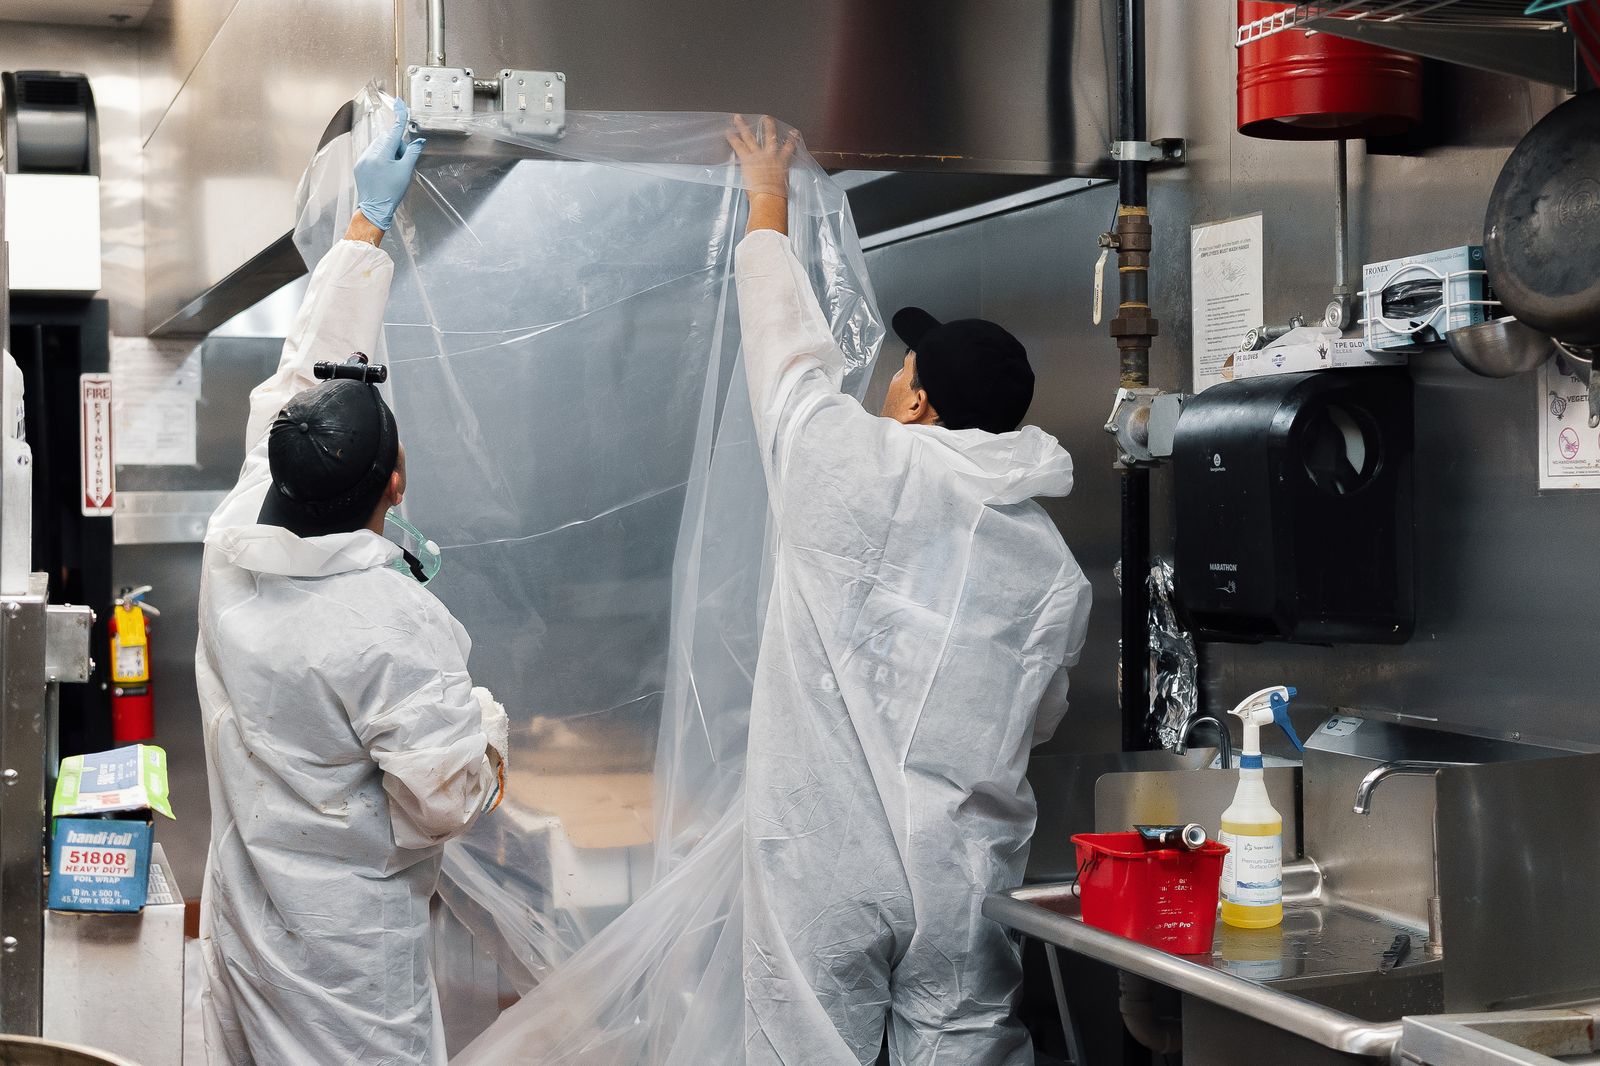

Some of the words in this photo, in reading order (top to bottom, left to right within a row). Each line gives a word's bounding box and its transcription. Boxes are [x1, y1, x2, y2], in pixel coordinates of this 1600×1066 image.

[1365, 264, 1389, 275] TRONEX
[1242, 353, 1259, 361] GLOVES
[86, 387, 110, 399] FIRE
[94, 402, 103, 501] EXTINGUISHER
[1209, 563, 1237, 571] MARATHON
[67, 830, 132, 846] handi-foil
[69, 850, 126, 865] 51808
[65, 865, 100, 873] HEAVY
[102, 866, 130, 874] DUTY
[73, 875, 94, 883] FOIL
[95, 876, 121, 884] WRAP
[71, 888, 80, 896] 18
[98, 889, 113, 897] 500
[101, 897, 121, 905] 152.4
